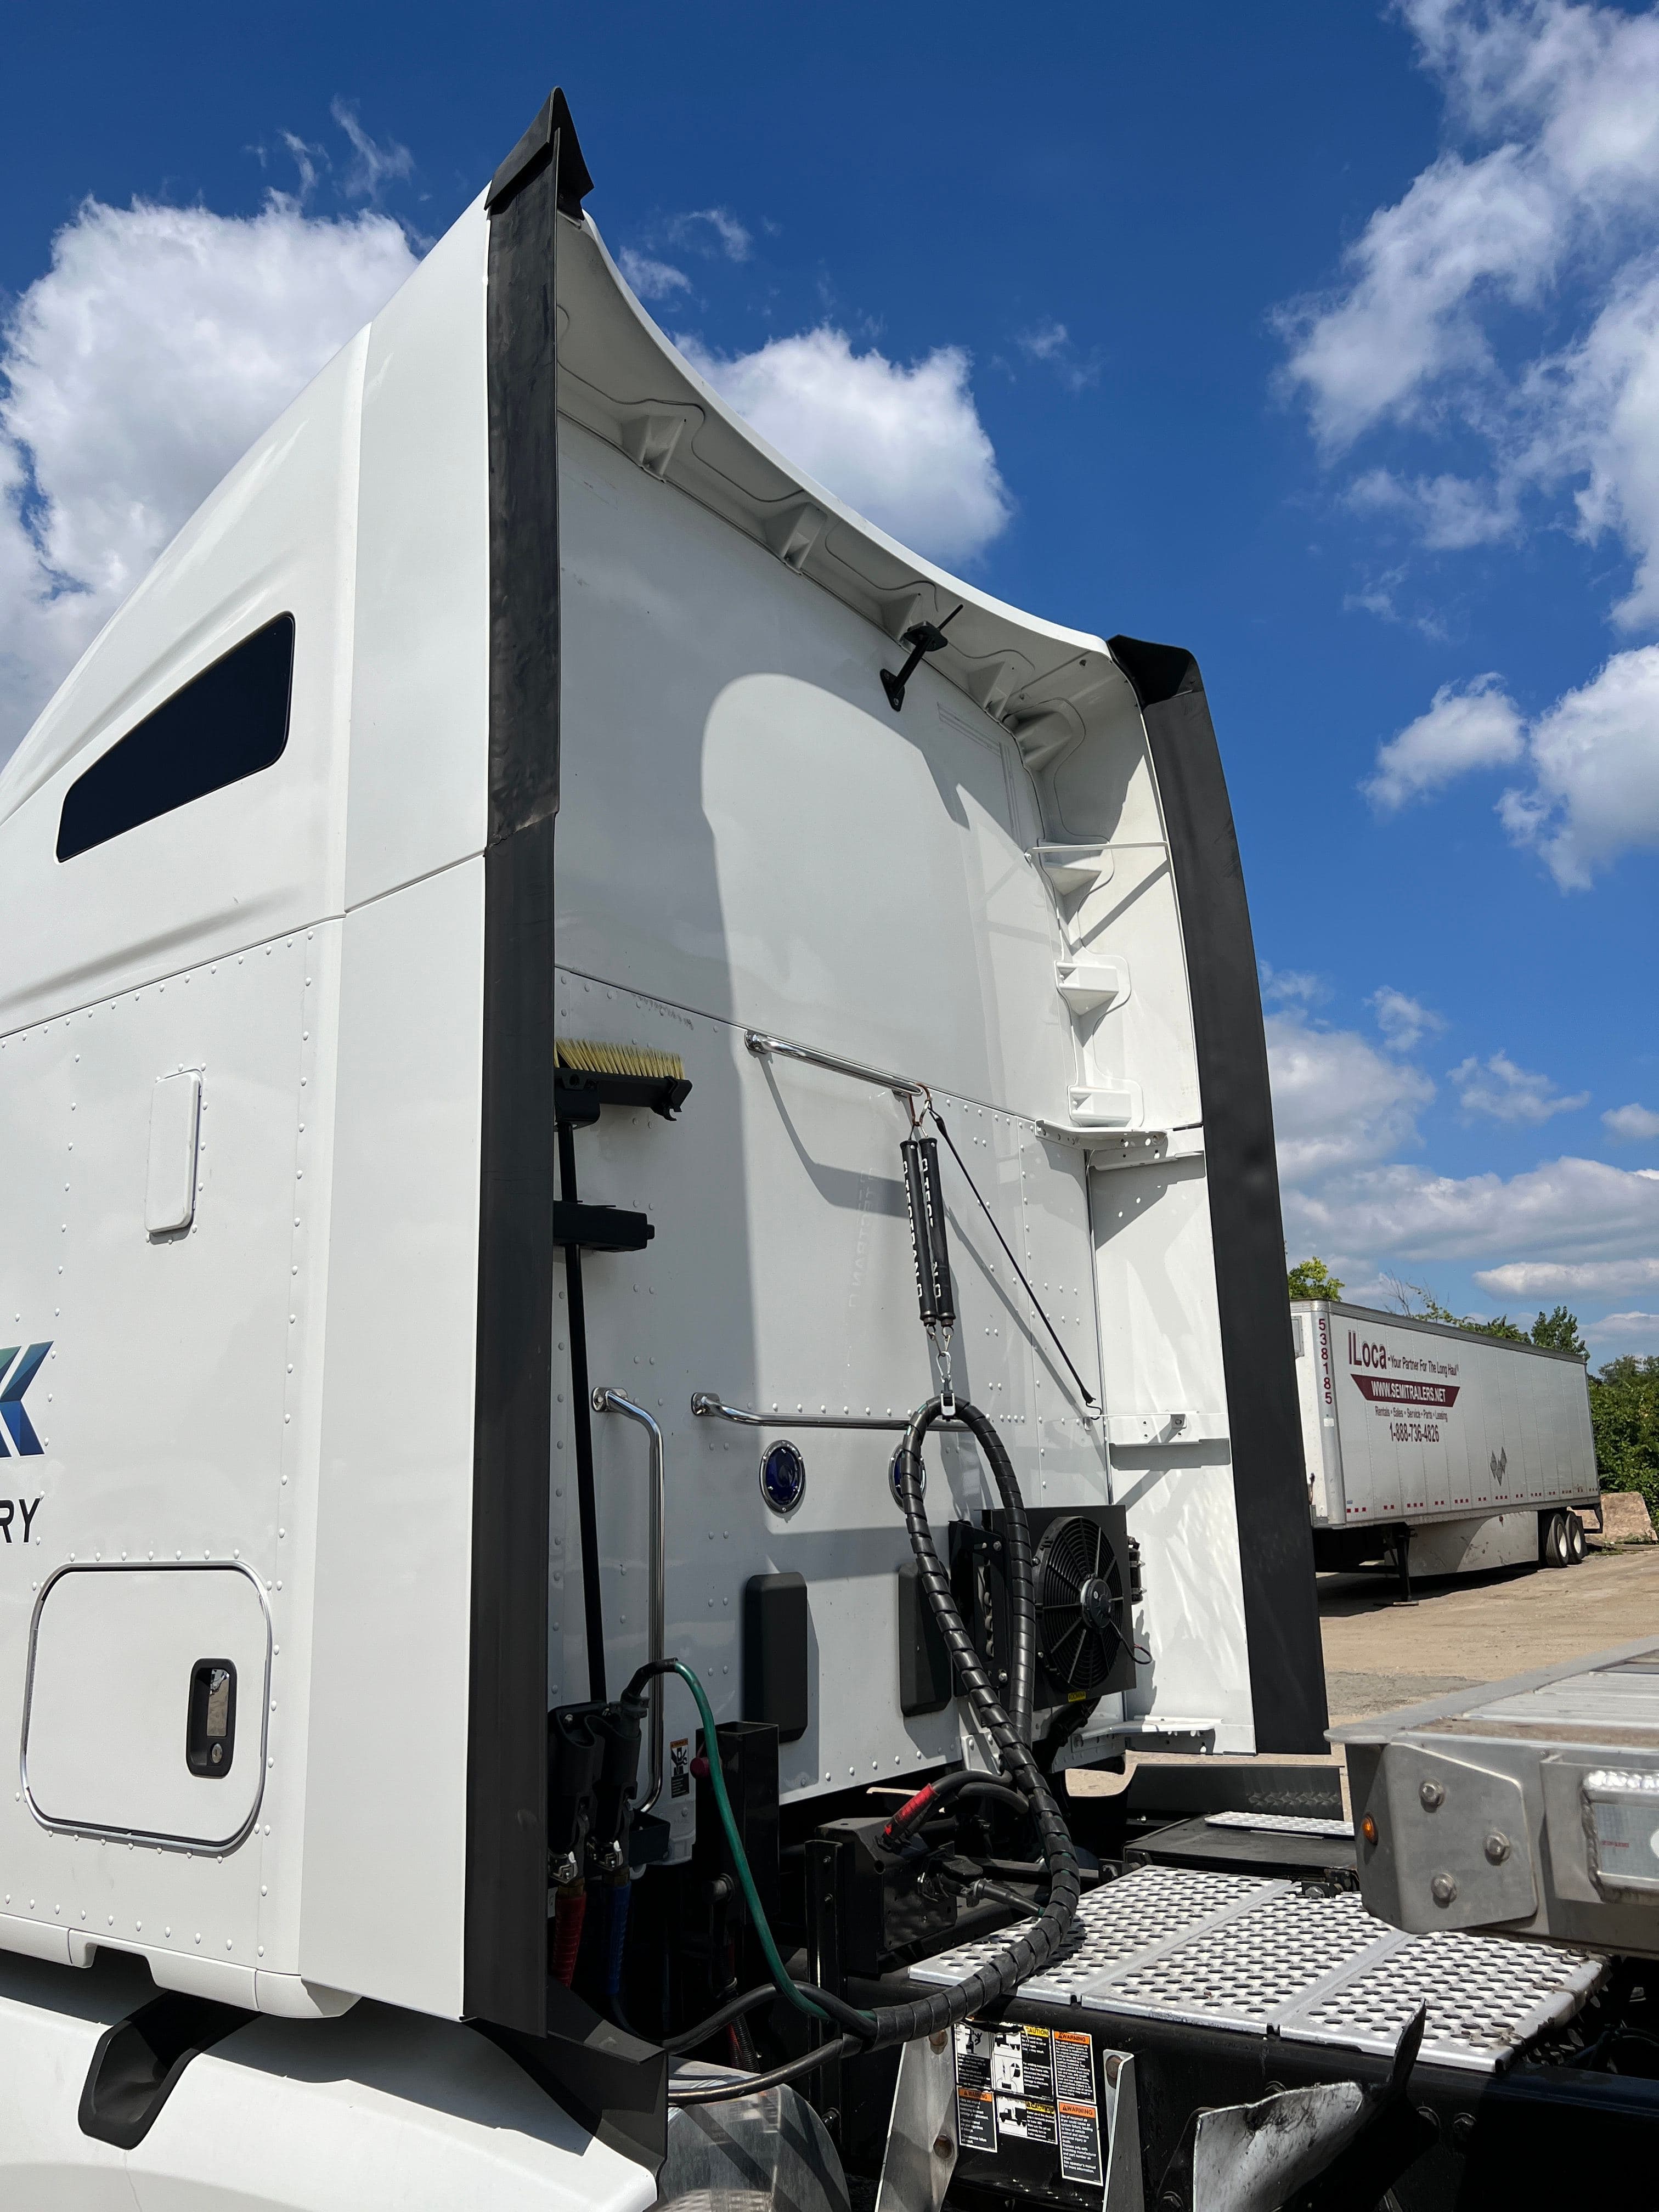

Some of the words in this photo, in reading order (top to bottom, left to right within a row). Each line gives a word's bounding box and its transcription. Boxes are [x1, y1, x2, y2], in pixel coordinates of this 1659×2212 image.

[1402, 1357, 1419, 1371] Partner
[1428, 1361, 1436, 1373] The
[1437, 1362, 1447, 1378] Long
[1371, 1380, 1446, 1402] WWW.SEMITRAILERS.NET
[1375, 1406, 1390, 1417] Rentals
[1393, 1407, 1403, 1418] Sales
[1407, 1408, 1420, 1419] Service
[1423, 1409, 1433, 1419] Parts
[1389, 1422, 1440, 1442] 1-888-736-4826
[1063, 2034, 1086, 2042] WARNING
[1066, 2106, 1093, 2115] WARNING
